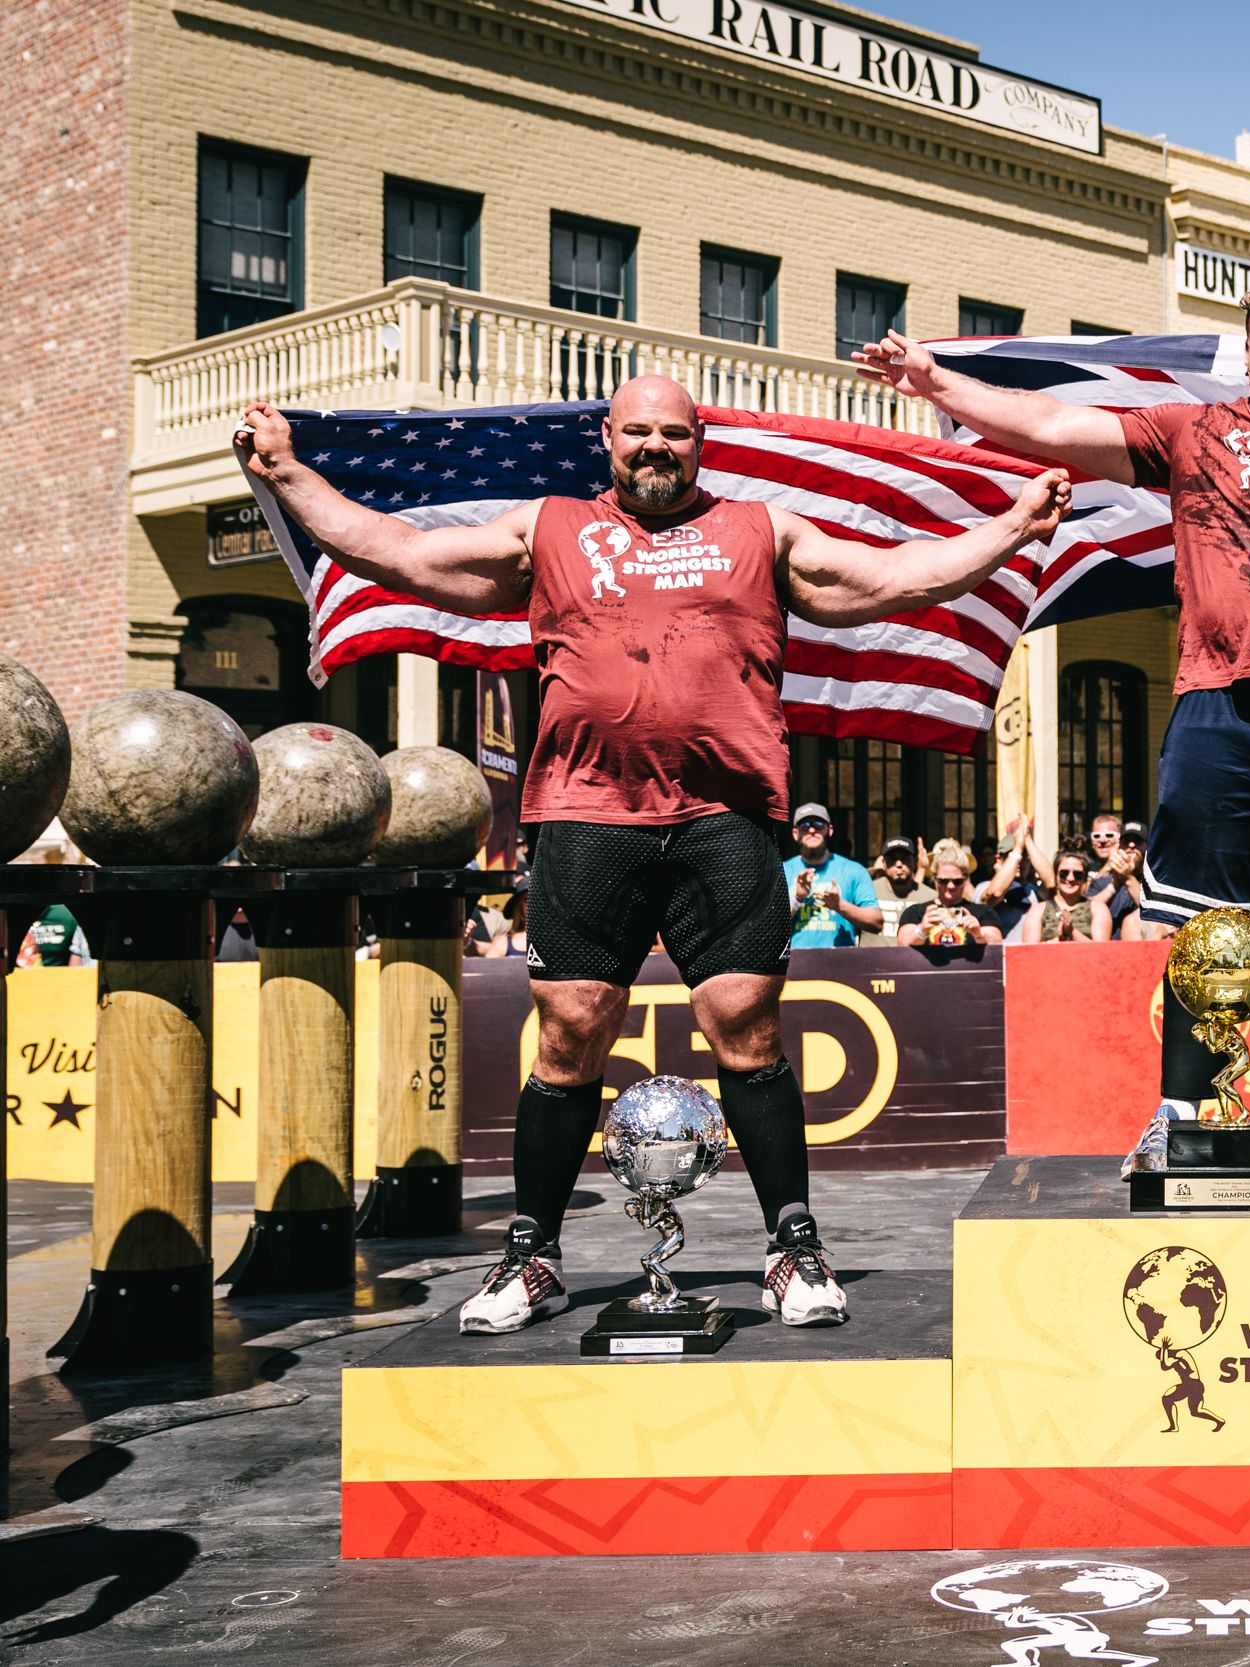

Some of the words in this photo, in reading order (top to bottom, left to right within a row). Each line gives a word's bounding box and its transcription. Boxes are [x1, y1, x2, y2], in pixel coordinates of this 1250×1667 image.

[709, 0, 840, 73] RAIL
[858, 37, 981, 109] ROAD
[1003, 85, 1089, 138] COMPANY
[652, 526, 703, 547] SBD
[635, 545, 721, 563] WORLD'S
[622, 557, 731, 575] STRONGEST
[654, 573, 703, 590] MAN
[870, 979, 895, 994] TM
[21, 1037, 96, 1075] Visi
[428, 996, 447, 1111] ROGUE
[513, 1237, 531, 1245] AIR
[793, 1230, 811, 1238] AIR
